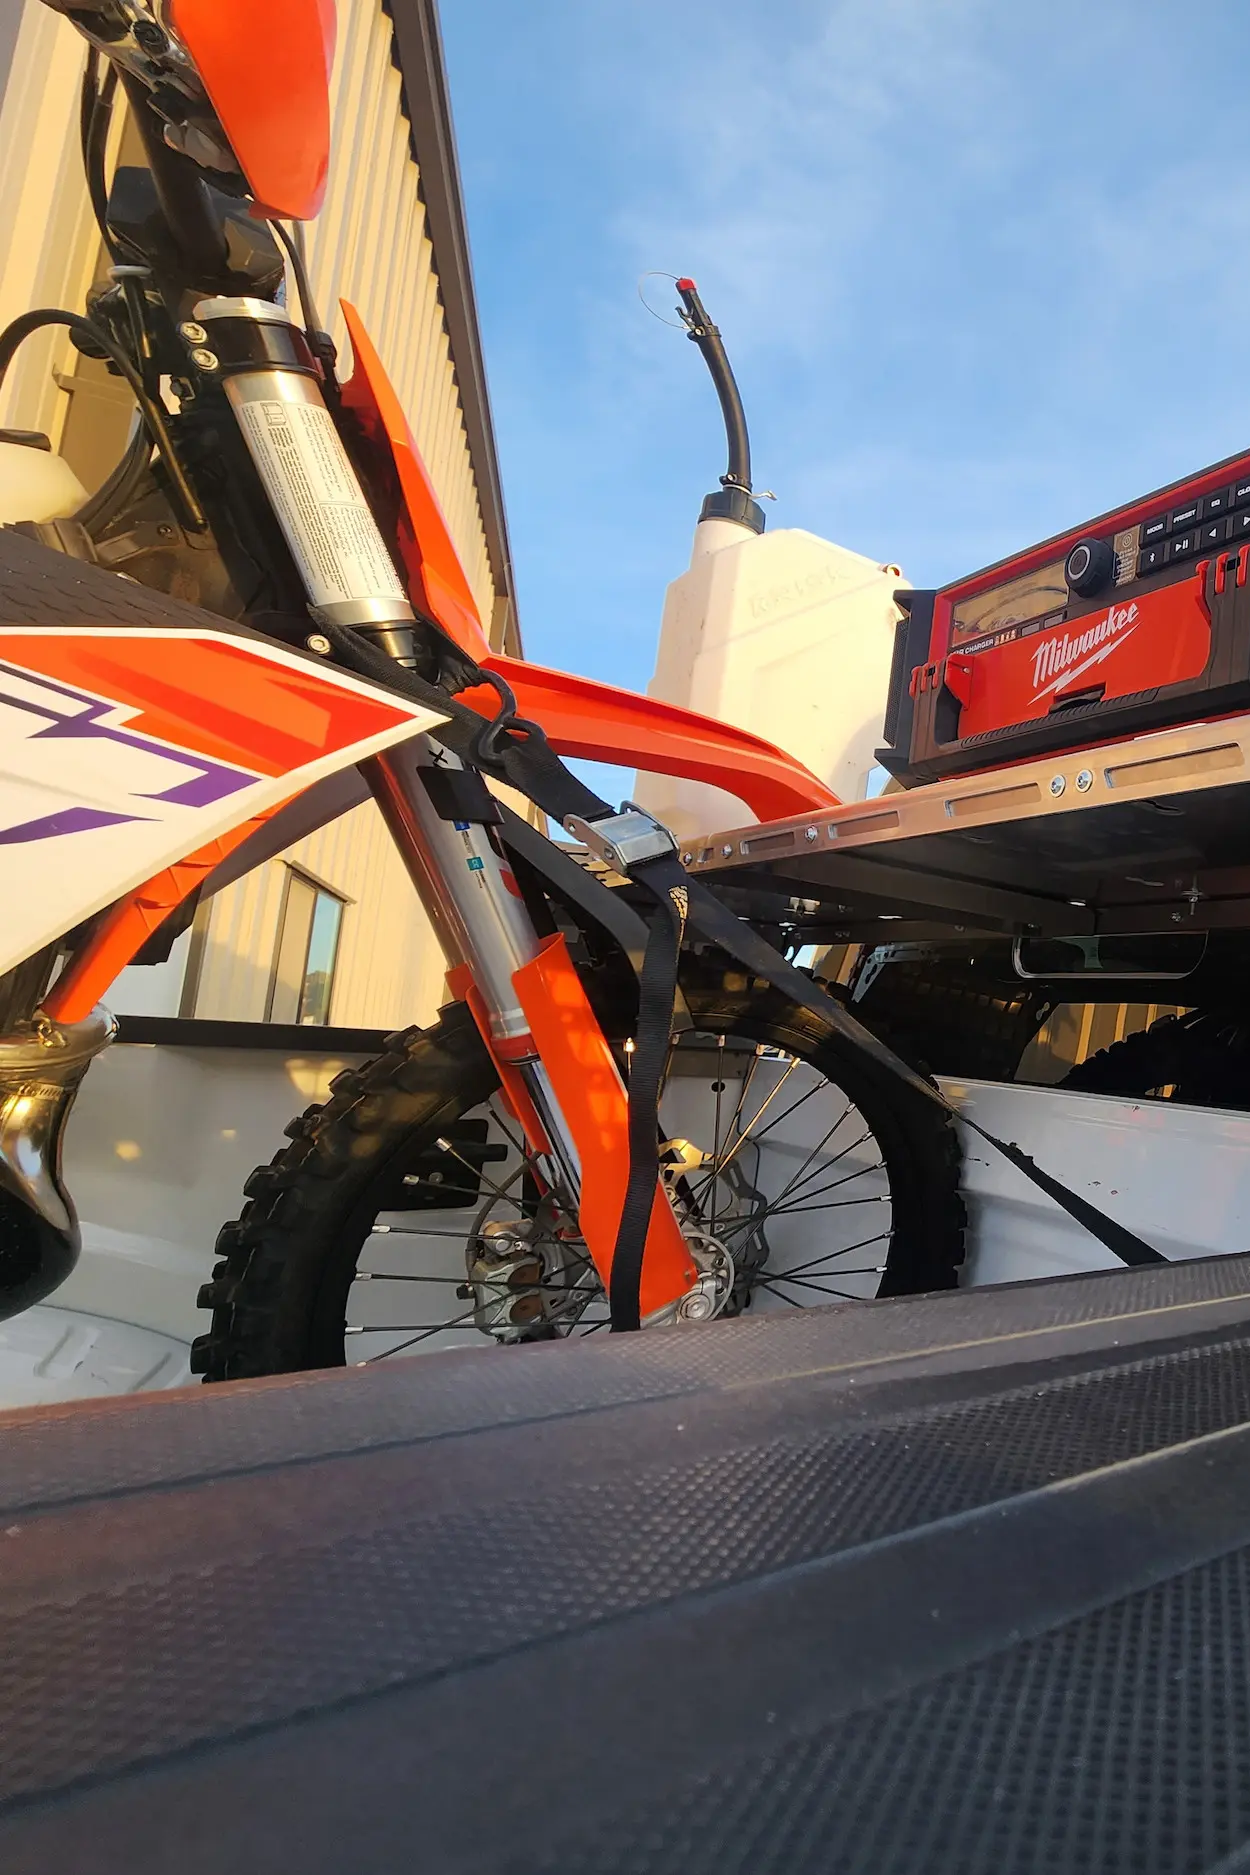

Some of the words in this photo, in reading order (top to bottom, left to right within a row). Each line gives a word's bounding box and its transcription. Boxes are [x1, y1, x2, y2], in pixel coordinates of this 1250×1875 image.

[1147, 523, 1164, 535] MODE
[1173, 509, 1196, 523] PRESET
[965, 639, 994, 654] CHARGER
[1029, 603, 1139, 688] Milwaukee
